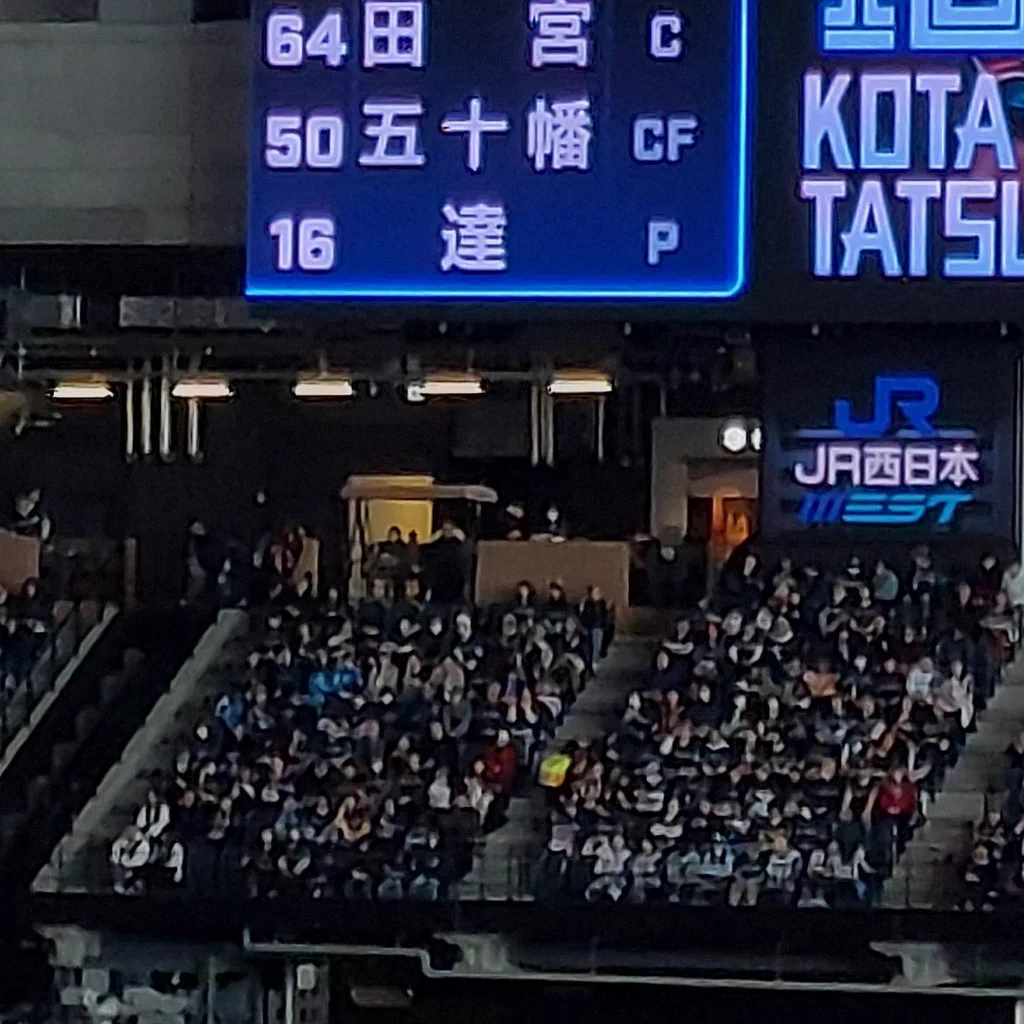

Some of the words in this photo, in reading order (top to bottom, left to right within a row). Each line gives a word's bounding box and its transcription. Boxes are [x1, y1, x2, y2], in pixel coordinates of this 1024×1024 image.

[265, 11, 348, 67] 64
[650, 14, 682, 58] C
[264, 113, 345, 169] 50
[633, 117, 697, 162] CF
[802, 71, 1017, 170] KOTA
[268, 215, 336, 271] 16
[440, 201, 507, 272] 達
[648, 220, 678, 264] P
[833, 375, 942, 438] JR
[793, 442, 981, 488] JR西日本
[800, 492, 974, 524] WEST
